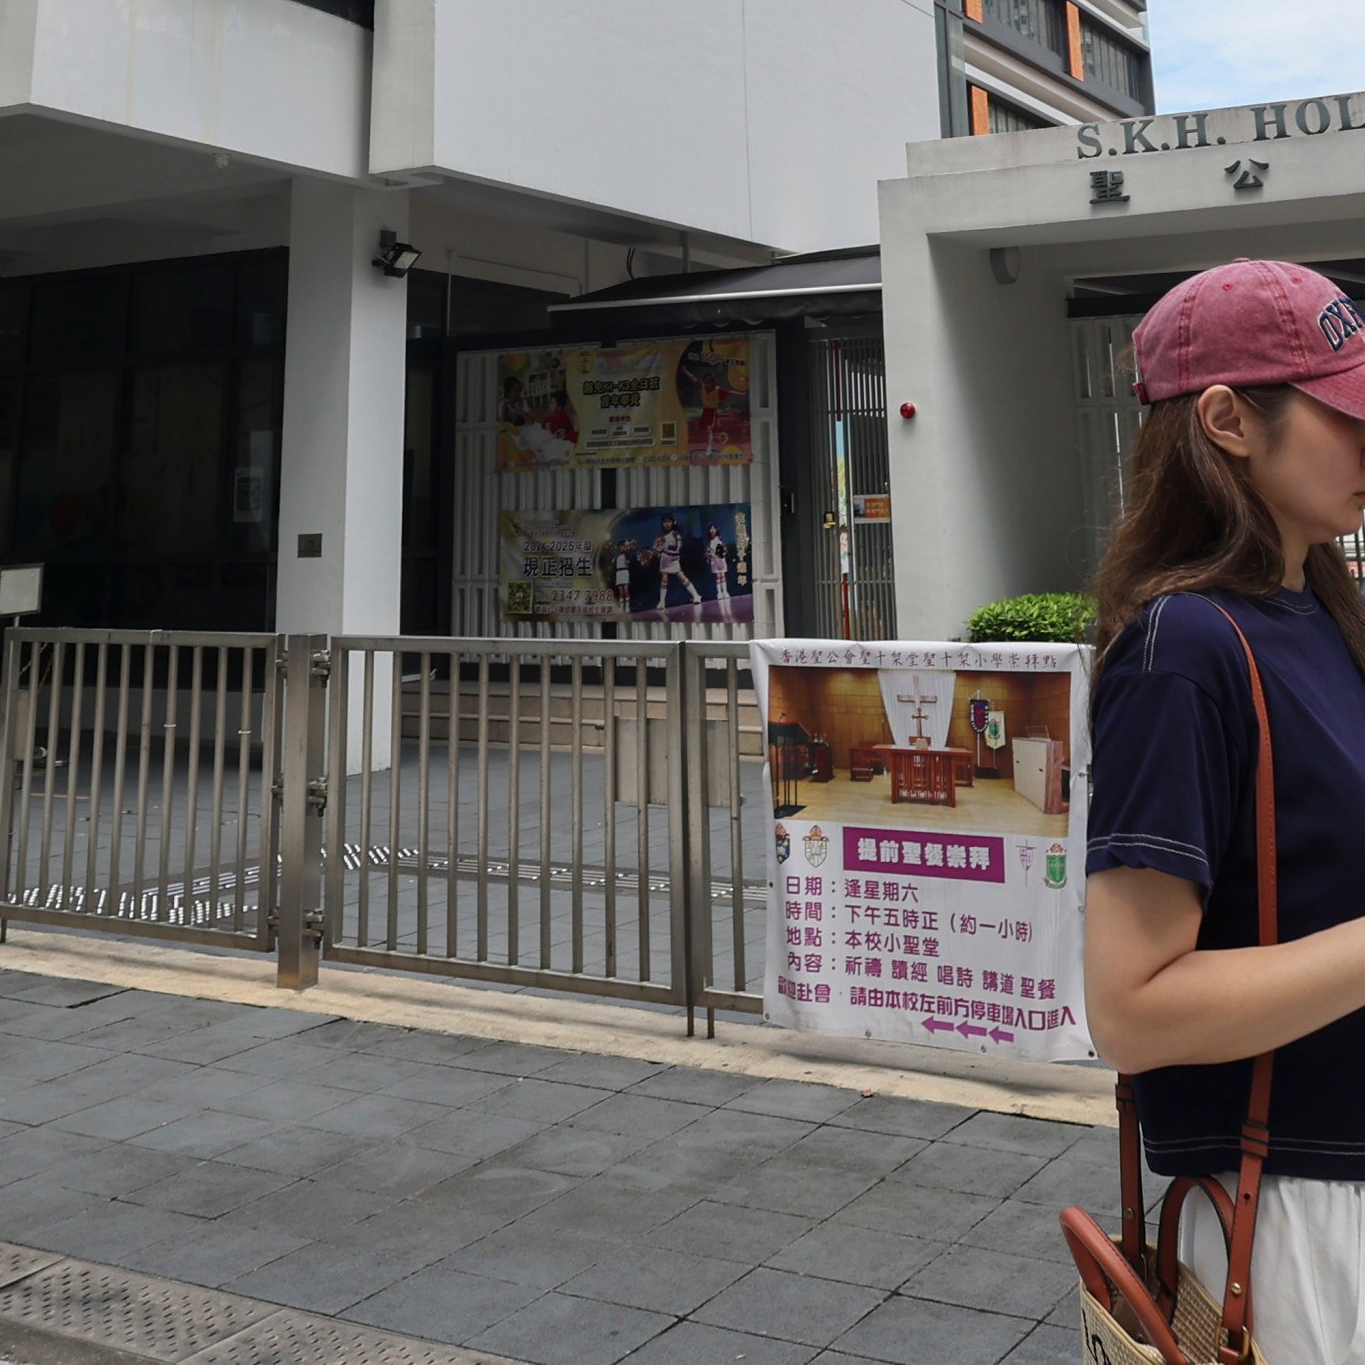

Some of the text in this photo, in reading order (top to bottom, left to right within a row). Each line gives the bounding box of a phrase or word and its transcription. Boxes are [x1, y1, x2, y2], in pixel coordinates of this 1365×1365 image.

[1076, 113, 1227, 159] S.K.H.
[522, 556, 593, 577] 現正招生
[552, 589, 580, 603] 2347
[857, 837, 990, 871] 提前聖餐崇拜
